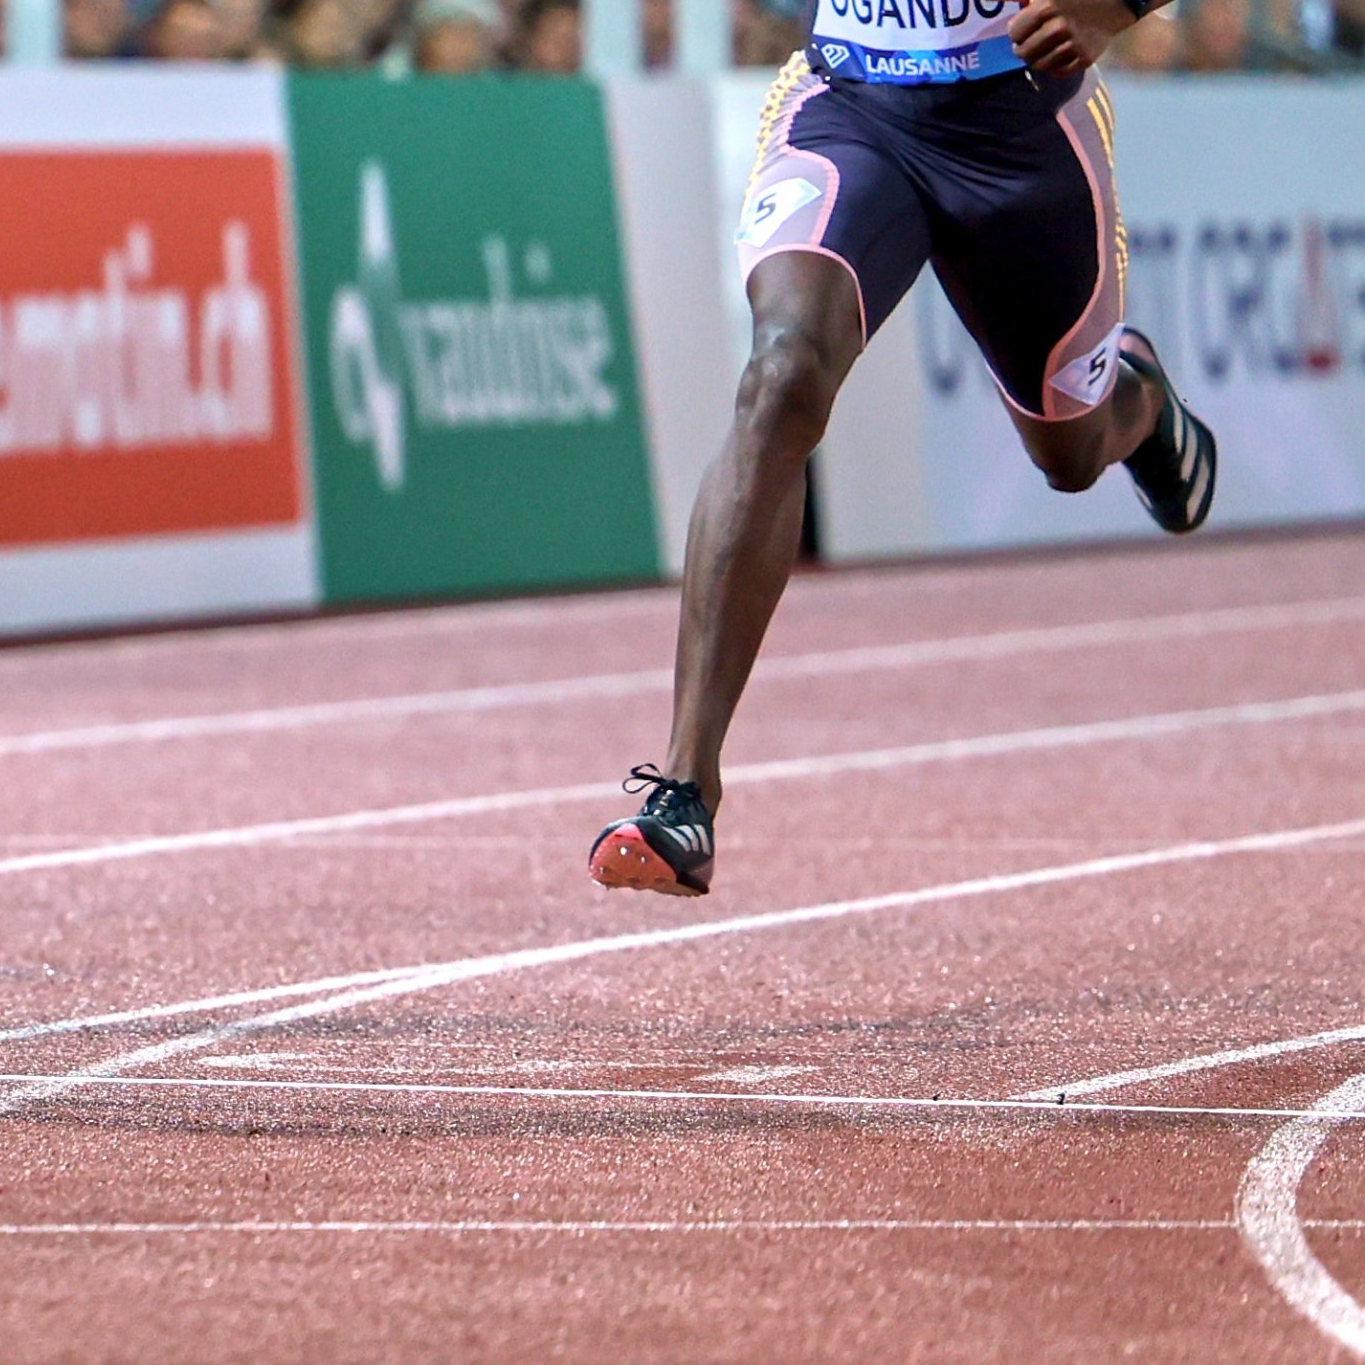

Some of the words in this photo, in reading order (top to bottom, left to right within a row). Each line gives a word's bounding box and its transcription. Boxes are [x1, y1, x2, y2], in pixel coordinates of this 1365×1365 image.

[866, 51, 981, 76] LAUSANNE
[755, 192, 777, 225] 5
[1088, 347, 1107, 386] 5
